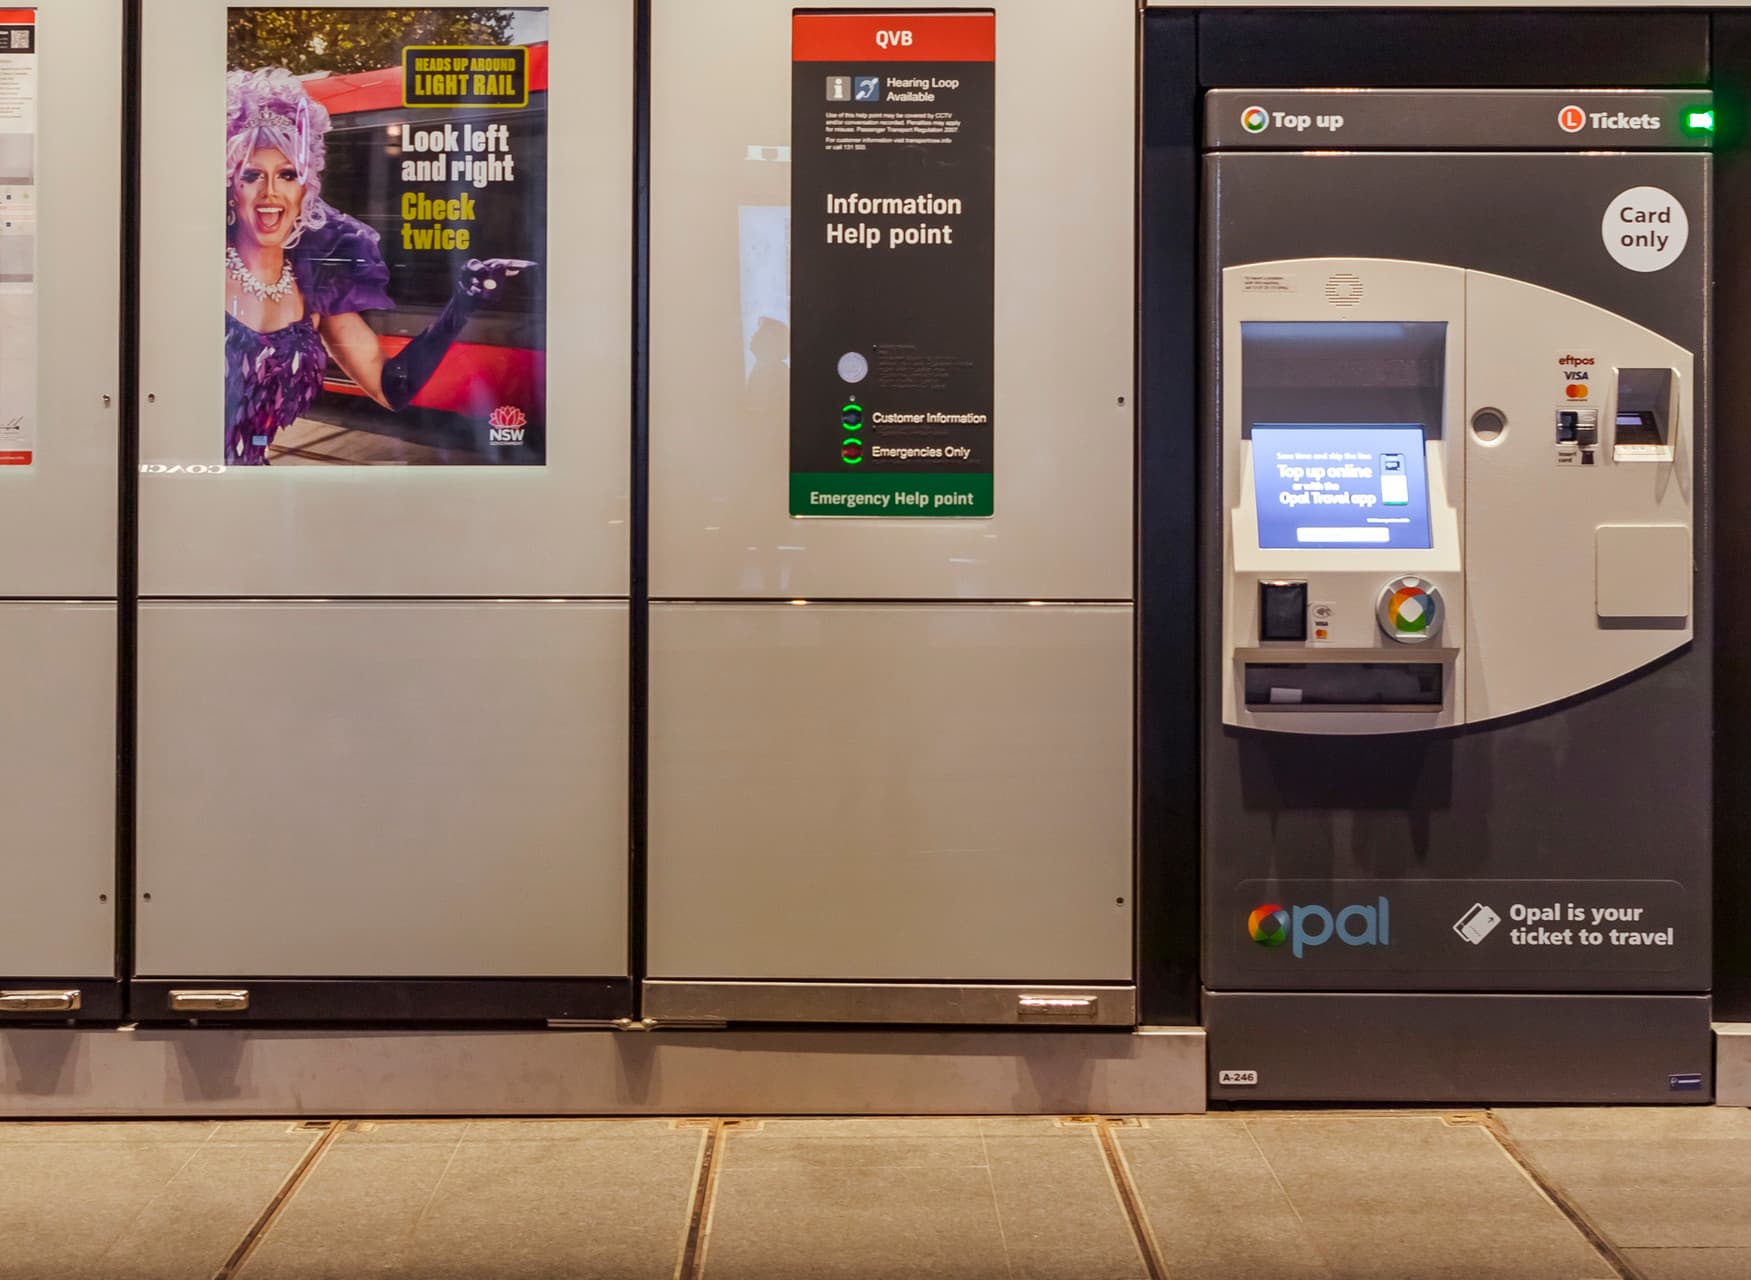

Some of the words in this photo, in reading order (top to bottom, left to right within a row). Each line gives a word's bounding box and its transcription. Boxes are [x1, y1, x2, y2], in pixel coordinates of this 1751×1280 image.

[875, 30, 913, 49] QVB
[415, 57, 452, 72] HEADS
[453, 57, 468, 72] UP
[470, 57, 516, 72] AROUND
[415, 74, 469, 96] LIGHT
[473, 74, 516, 96] RAIL
[886, 78, 930, 90] Hearing
[932, 78, 960, 90] Loop
[886, 92, 935, 102] Available
[1272, 111, 1311, 131] Top
[1317, 116, 1344, 131] up
[1589, 111, 1661, 129] Tickets
[401, 125, 460, 152] Look
[464, 124, 509, 152] left
[401, 154, 447, 182] and
[451, 153, 514, 187] right
[401, 192, 475, 221] Check
[827, 194, 961, 215] Information
[1619, 206, 1672, 224] Card
[401, 223, 470, 250] twice
[827, 224, 881, 248] Help
[890, 224, 952, 248] point
[1620, 231, 1669, 253] only
[1558, 355, 1595, 367] eftpos
[1563, 371, 1589, 380] VISA
[872, 412, 925, 423] Customer
[926, 412, 987, 423] Information
[489, 429, 525, 441] NSW
[871, 446, 943, 459] Emergencies
[944, 446, 971, 459] Only
[1276, 464, 1304, 481] Top
[1306, 467, 1325, 481] up
[1327, 463, 1373, 478] online
[810, 491, 890, 508] Emergency
[895, 491, 930, 507] Help
[934, 491, 974, 507] point
[1279, 491, 1309, 507] Opal
[1310, 491, 1350, 504] Travel
[1351, 494, 1377, 507] app
[1509, 903, 1561, 925] Opal
[1567, 903, 1586, 921] is
[1591, 907, 1643, 925] your
[1509, 928, 1573, 945] ticket
[1578, 929, 1603, 945] to
[1609, 928, 1674, 945] travel
[1222, 1073, 1255, 1082] A-246
